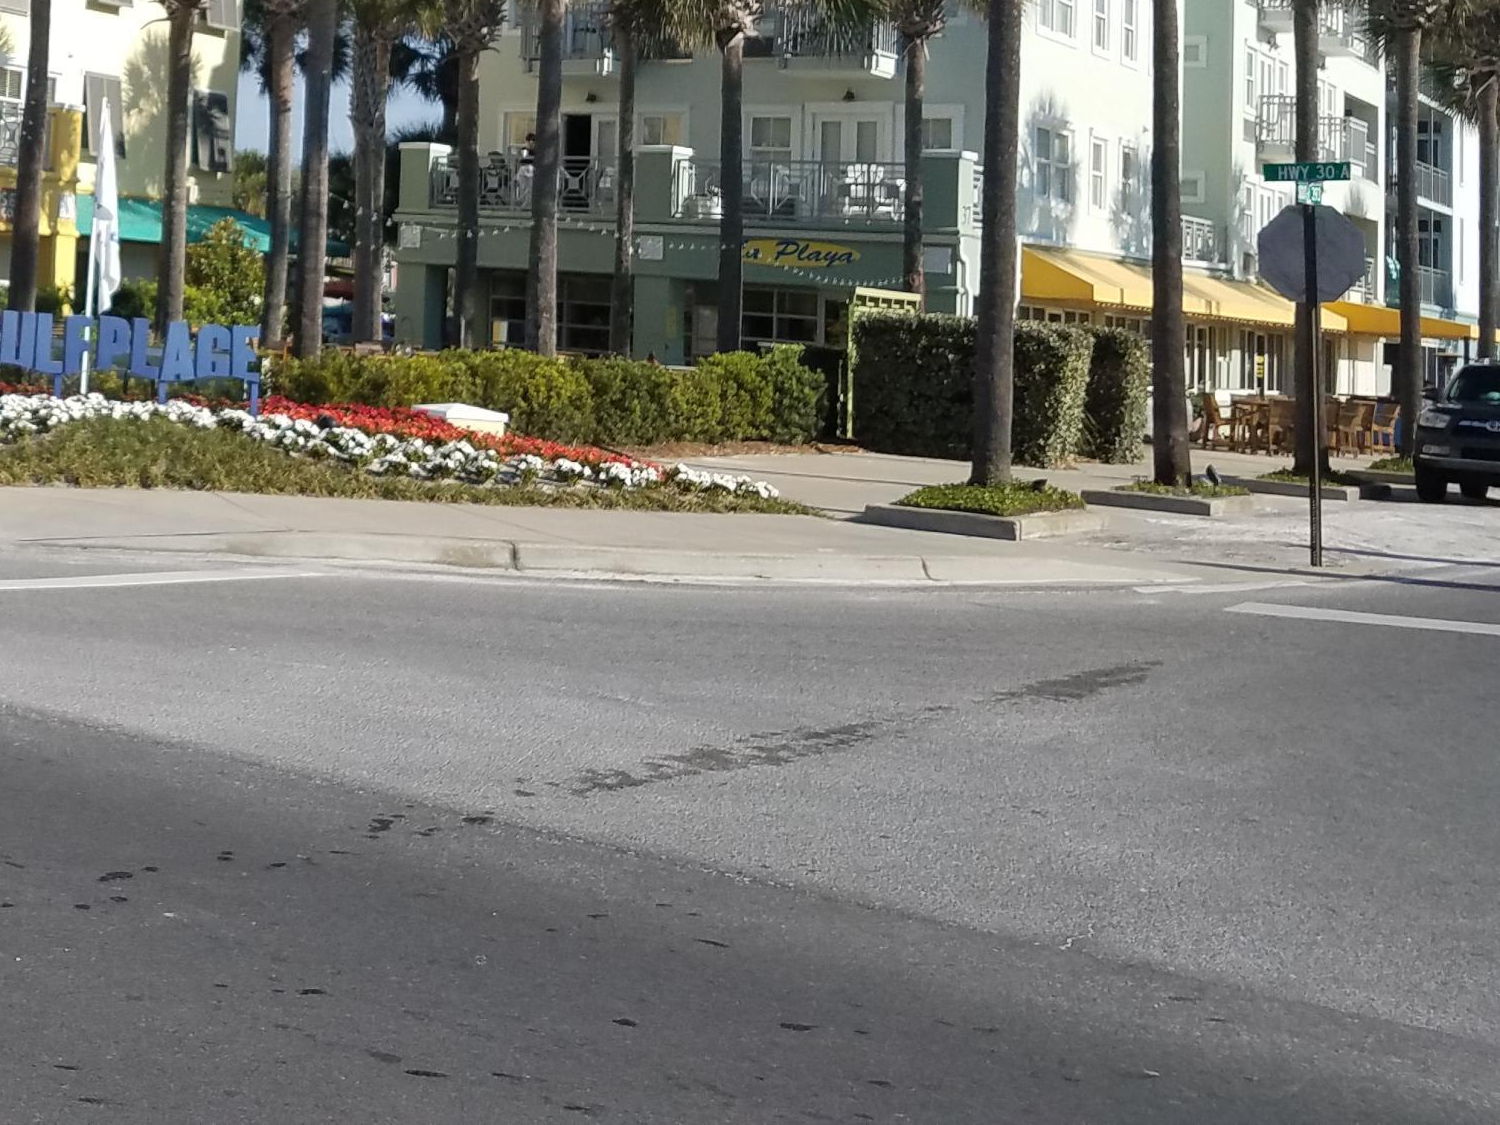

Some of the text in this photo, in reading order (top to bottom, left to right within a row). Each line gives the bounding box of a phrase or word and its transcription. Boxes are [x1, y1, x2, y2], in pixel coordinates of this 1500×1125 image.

[1277, 165, 1310, 180] HWY
[775, 239, 853, 268] Playa
[96, 315, 260, 381] PLACE
